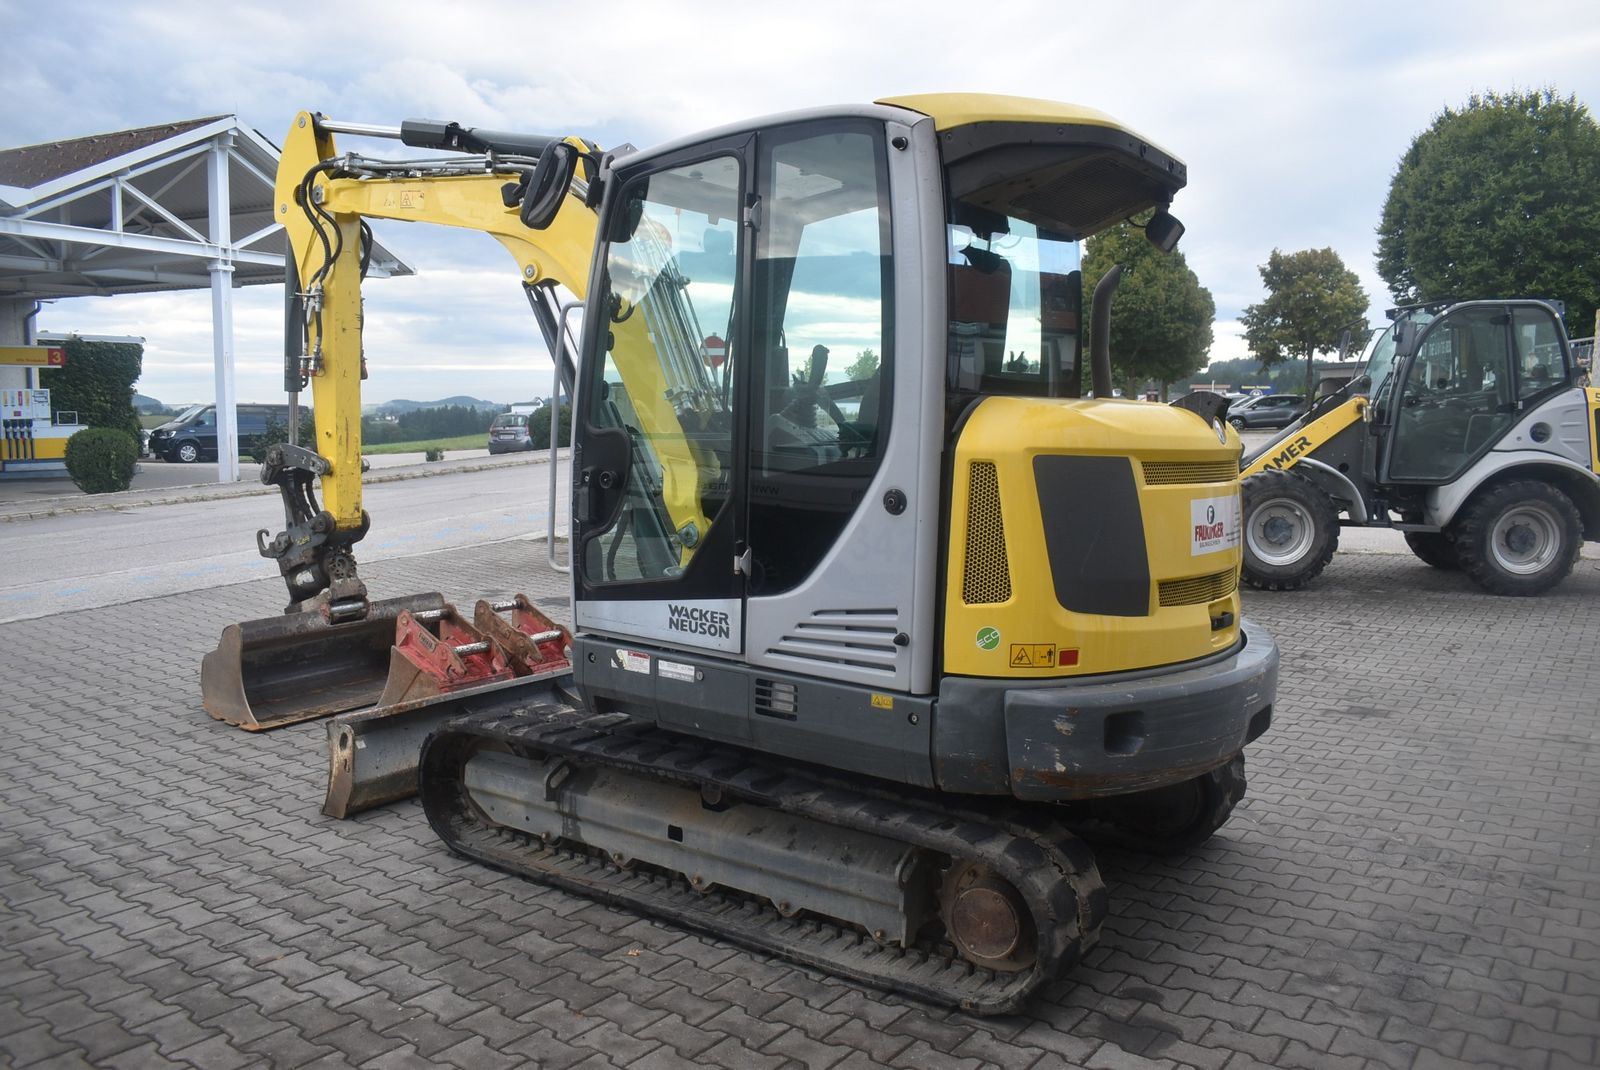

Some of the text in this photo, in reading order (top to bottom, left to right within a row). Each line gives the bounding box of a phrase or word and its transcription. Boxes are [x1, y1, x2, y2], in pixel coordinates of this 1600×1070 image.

[52, 351, 61, 363] 3
[668, 604, 729, 626] WACKER
[669, 616, 730, 639] NEUSON
[976, 630, 1000, 647] ECO
